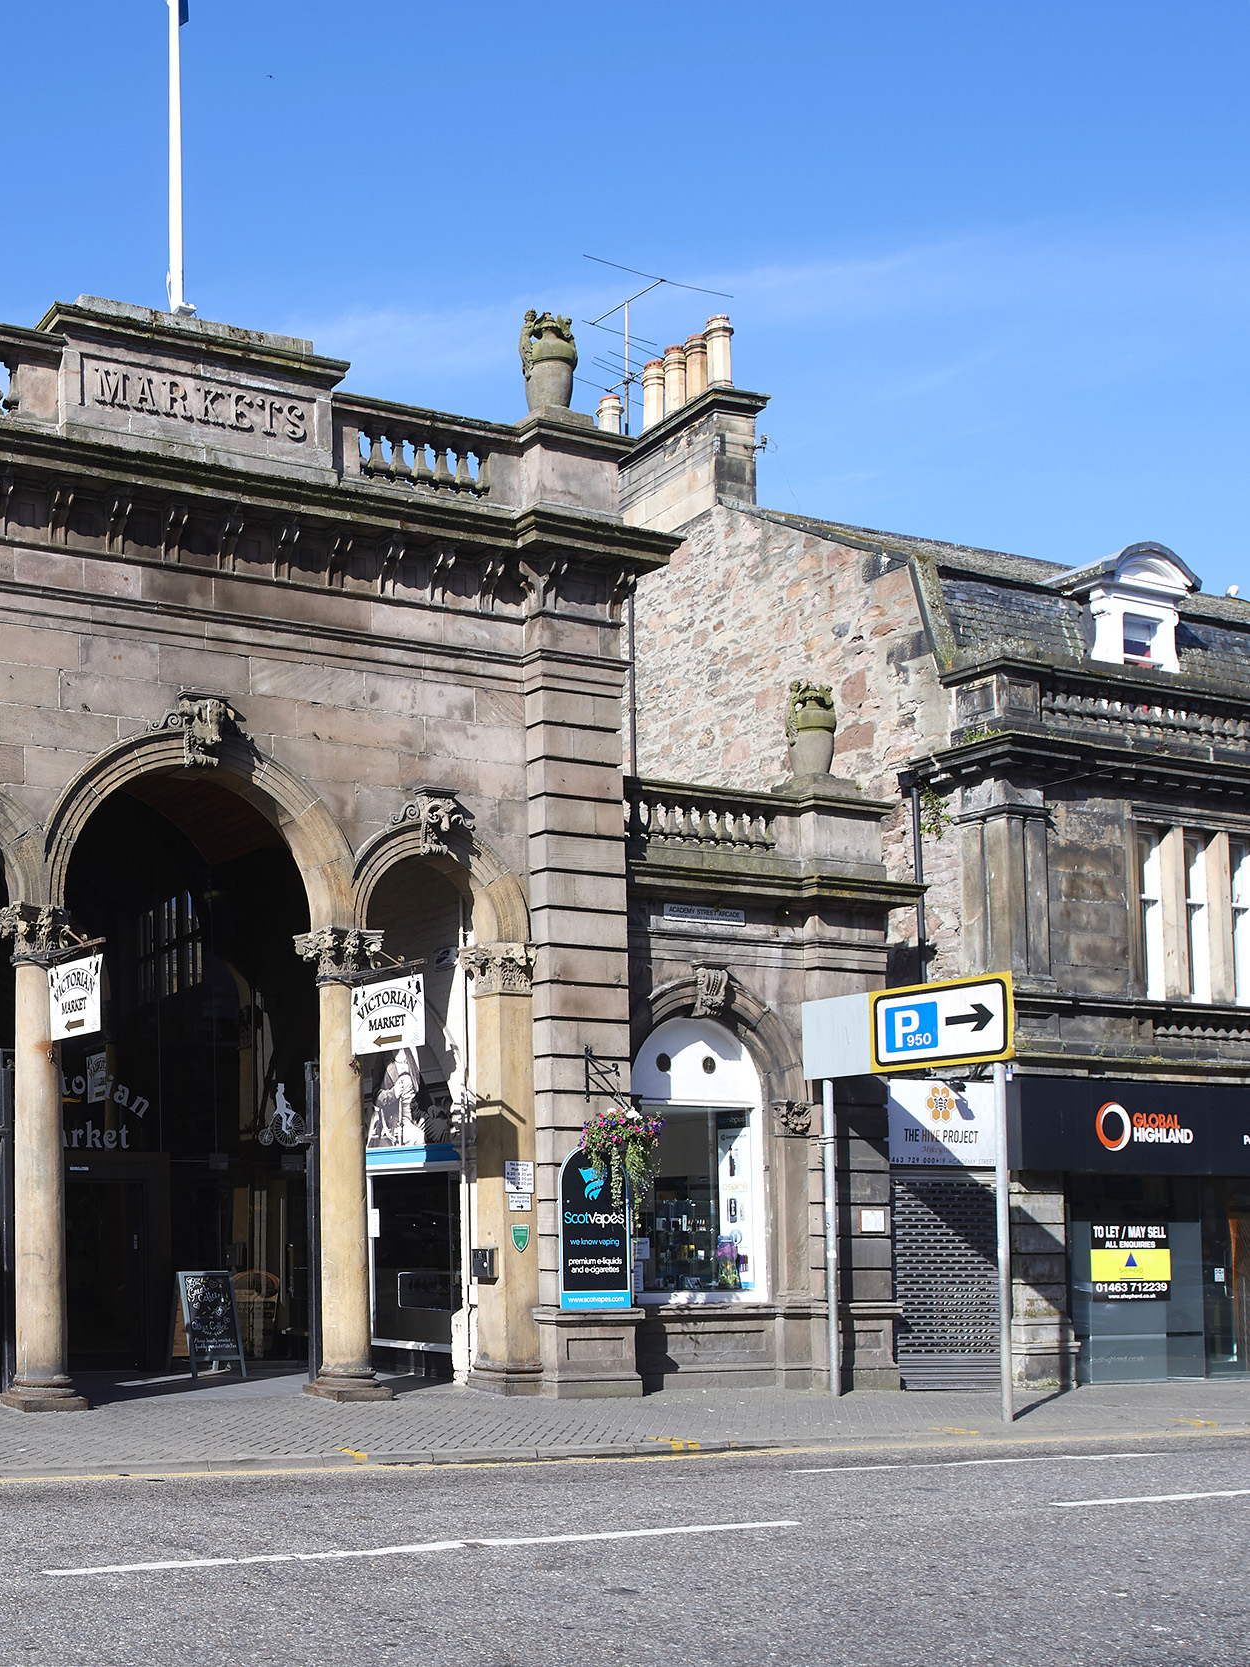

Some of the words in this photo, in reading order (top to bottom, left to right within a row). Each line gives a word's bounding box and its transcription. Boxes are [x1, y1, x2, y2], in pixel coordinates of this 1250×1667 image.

[95, 368, 307, 443] MARKETS
[669, 906, 695, 914] ACADEMY
[697, 908, 717, 916] STREET
[54, 971, 95, 1002] VICTORIAN
[62, 996, 87, 1015] MARKET
[357, 990, 417, 1020] VICTORIAN
[368, 1014, 406, 1032] MARKET
[894, 1009, 920, 1048] P
[907, 1032, 932, 1047] 950
[1132, 1112, 1181, 1129] GLOBAL
[904, 1128, 920, 1142] THE
[922, 1129, 941, 1143] HIVE
[942, 1130, 979, 1144] PROJECT
[1133, 1127, 1194, 1144] HIGHLAND
[1093, 1226, 1105, 1239] TO
[1106, 1226, 1120, 1239] LET
[1128, 1226, 1146, 1239] MAY
[1147, 1226, 1167, 1239] SELL
[581, 1238, 598, 1246] know
[599, 1238, 620, 1247] vaping
[568, 1257, 597, 1267] premium
[597, 1257, 623, 1265] e-liquids
[585, 1266, 620, 1275] e-cigarettes
[1096, 1283, 1128, 1293] 01463
[1130, 1283, 1168, 1292] 712239
[568, 1296, 625, 1304] www.scotvapes.com
